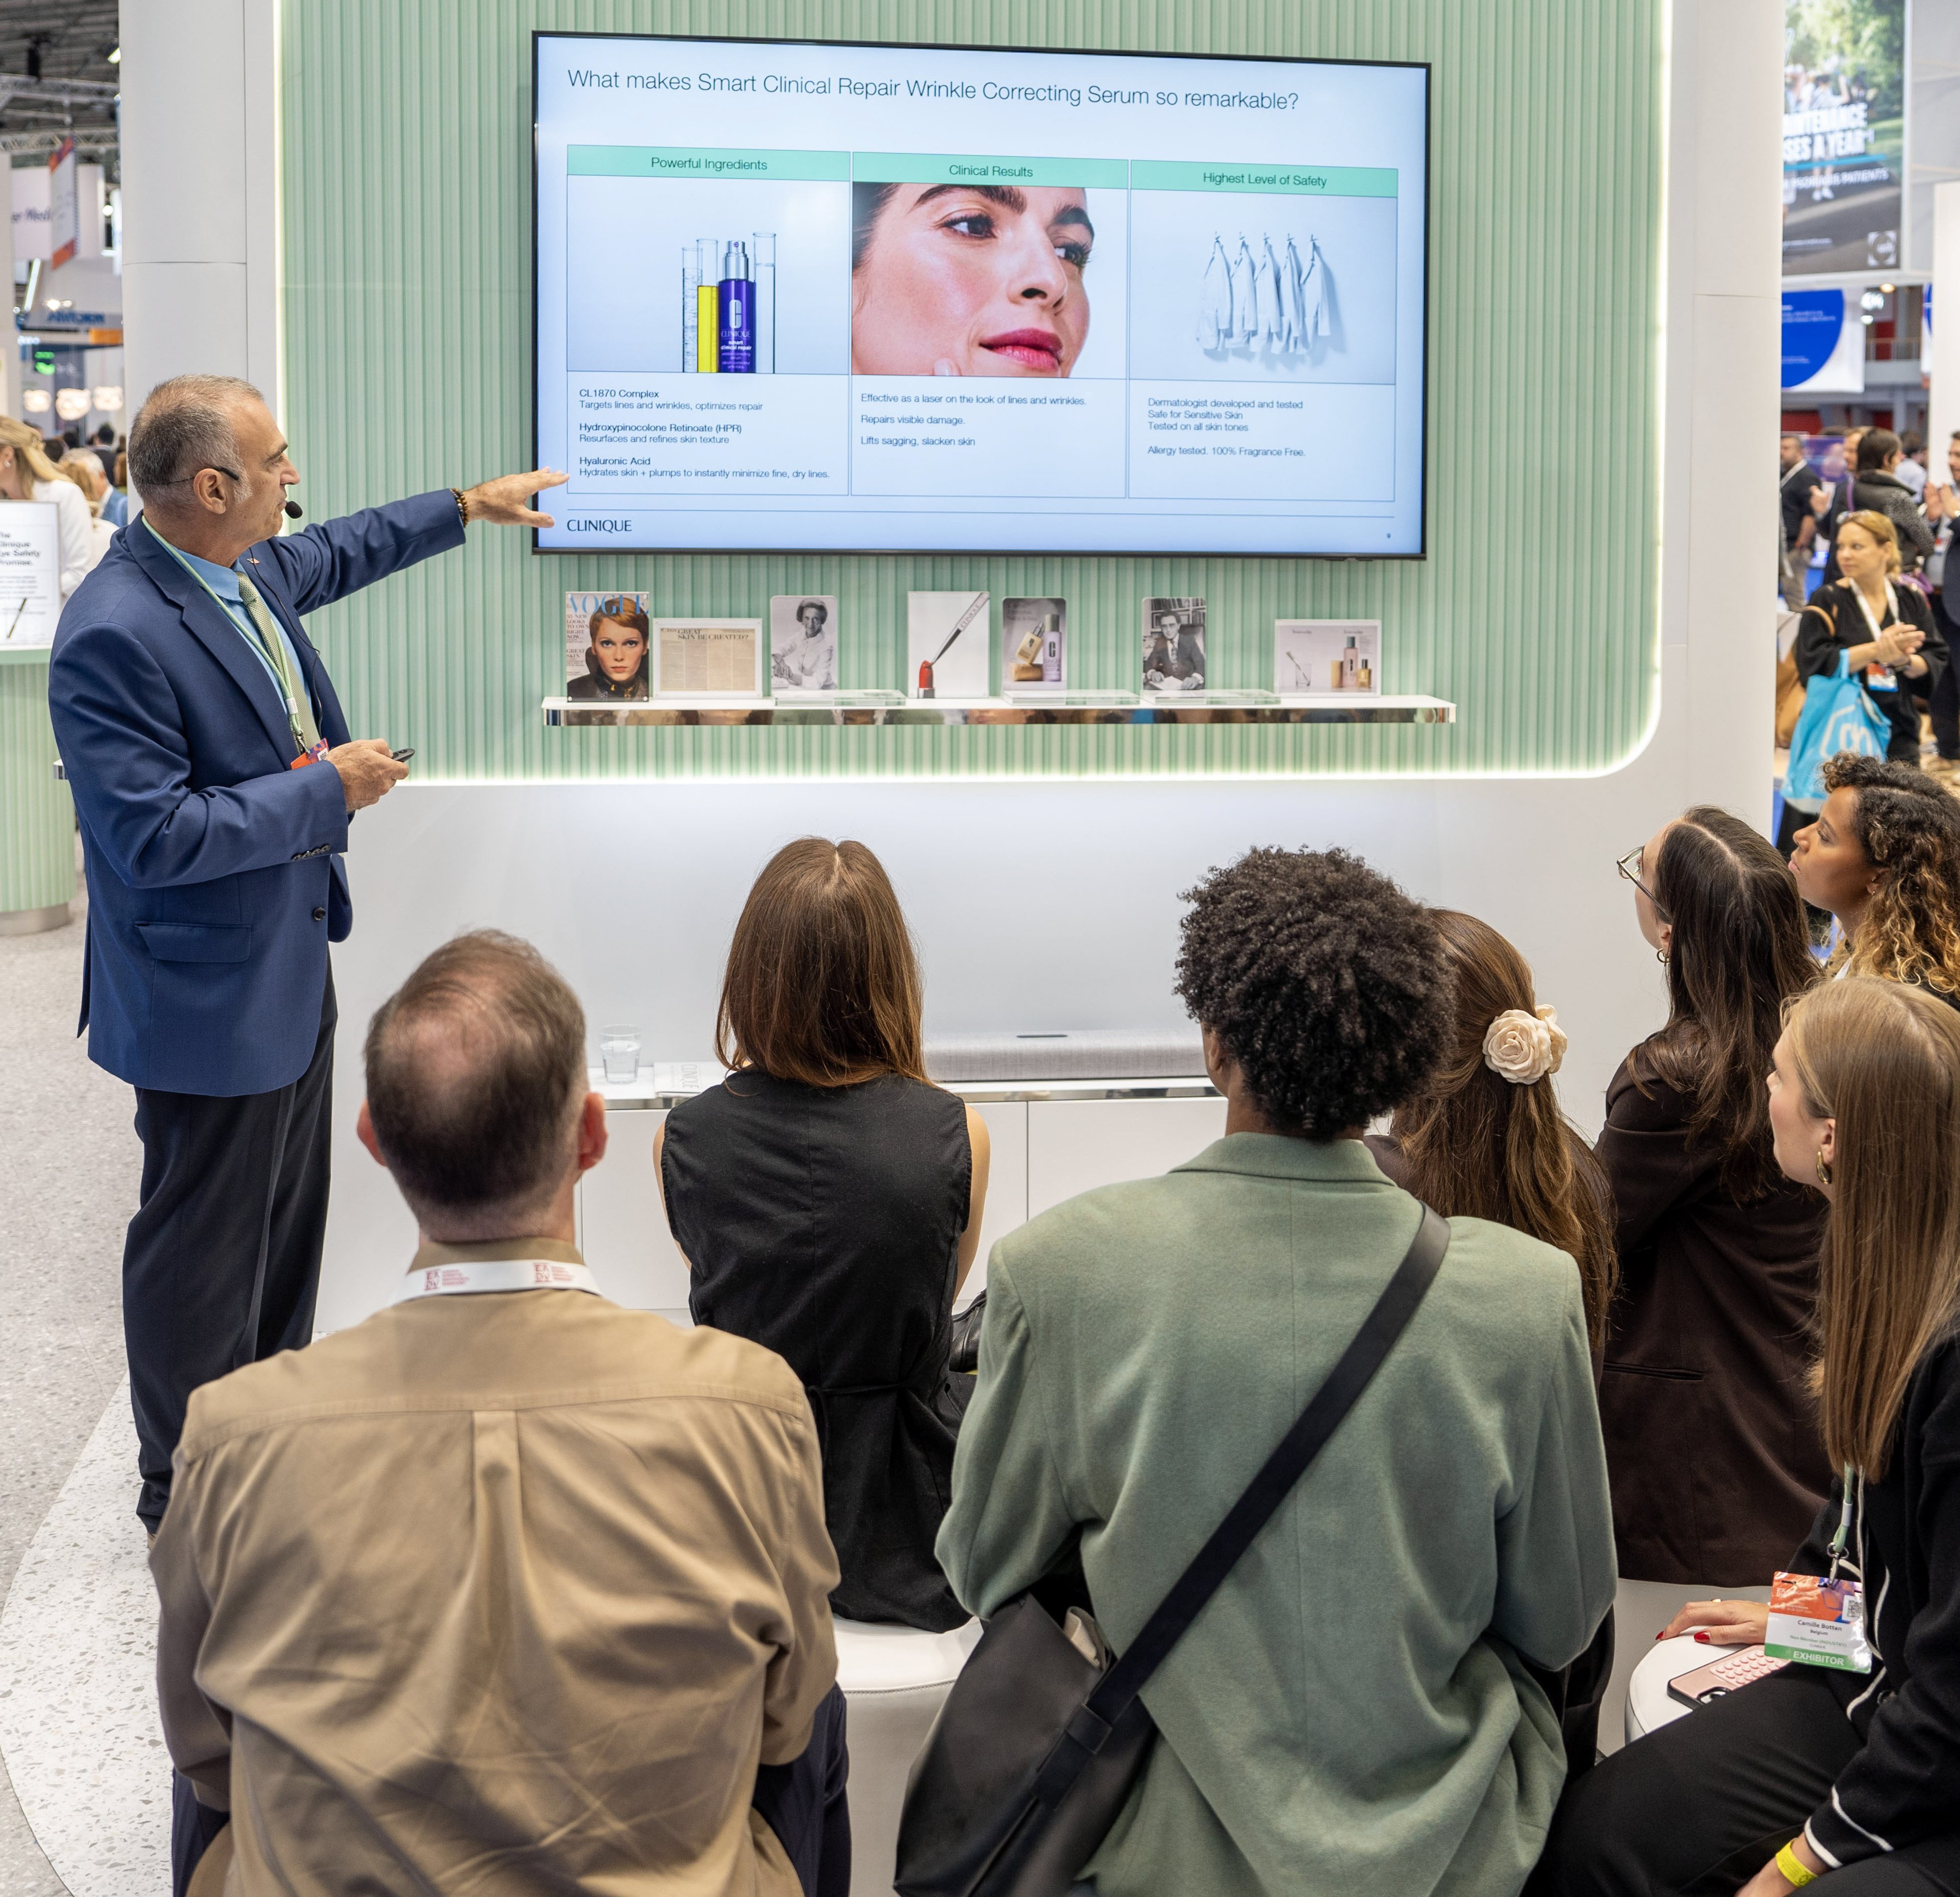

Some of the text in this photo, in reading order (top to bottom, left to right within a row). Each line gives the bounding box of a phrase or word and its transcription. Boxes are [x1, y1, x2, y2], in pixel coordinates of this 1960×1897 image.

[568, 69, 1299, 110] What makes Smart Clinical Repair Wrinkle Correcting Serum so remarkable?
[651, 157, 768, 172] Powerful Ingredients
[949, 164, 1033, 178] Clinical Results
[1203, 172, 1327, 189] Highest Level of Safety
[579, 389, 659, 400] CL1870 Complex
[861, 393, 899, 403] Effective
[922, 394, 944, 403] laser
[959, 395, 974, 404] the
[976, 395, 995, 404] look
[996, 395, 1006, 404] of
[1008, 395, 1028, 404] lines
[1029, 396, 1047, 405] and
[1049, 396, 1087, 405] wrinkles.
[579, 400, 764, 412] Targets lines and wrinkles, optimizes repair
[1148, 398, 1304, 409] Dermatologist developed and tested
[861, 414, 965, 426] Repairs visible damage.
[1148, 409, 1243, 420] Safe for Sensitive Skin
[579, 423, 742, 434] Hydroxypinocolone Retinoate (HPR)
[1148, 421, 1178, 430] Tested
[1193, 422, 1203, 431] all
[1205, 422, 1222, 431] skin
[1224, 423, 1249, 432] tones
[580, 433, 730, 444] Resurfaces and refines skin texture
[861, 436, 976, 447] Lifts sagging, slacken skin
[1147, 445, 1306, 458] Allergy tested. 100% Fragrance Free.
[580, 456, 651, 467] Hyaluronic Acid
[579, 467, 619, 478] Hydrates
[621, 468, 638, 476] skin
[649, 468, 681, 478] plumps
[683, 469, 692, 477] to
[694, 468, 730, 479] instantly
[732, 469, 770, 477] minimize
[772, 469, 790, 479] fine,
[792, 469, 806, 480] dry
[808, 470, 830, 478] lines.
[567, 520, 632, 534] CLINIQUE
[569, 594, 649, 615] VOGUE
[1798, 1620, 1842, 1631] Camille Botten
[1819, 1639, 1847, 1648] (INDUSTRY)
[1793, 1650, 1845, 1666] EXHIBITOR
